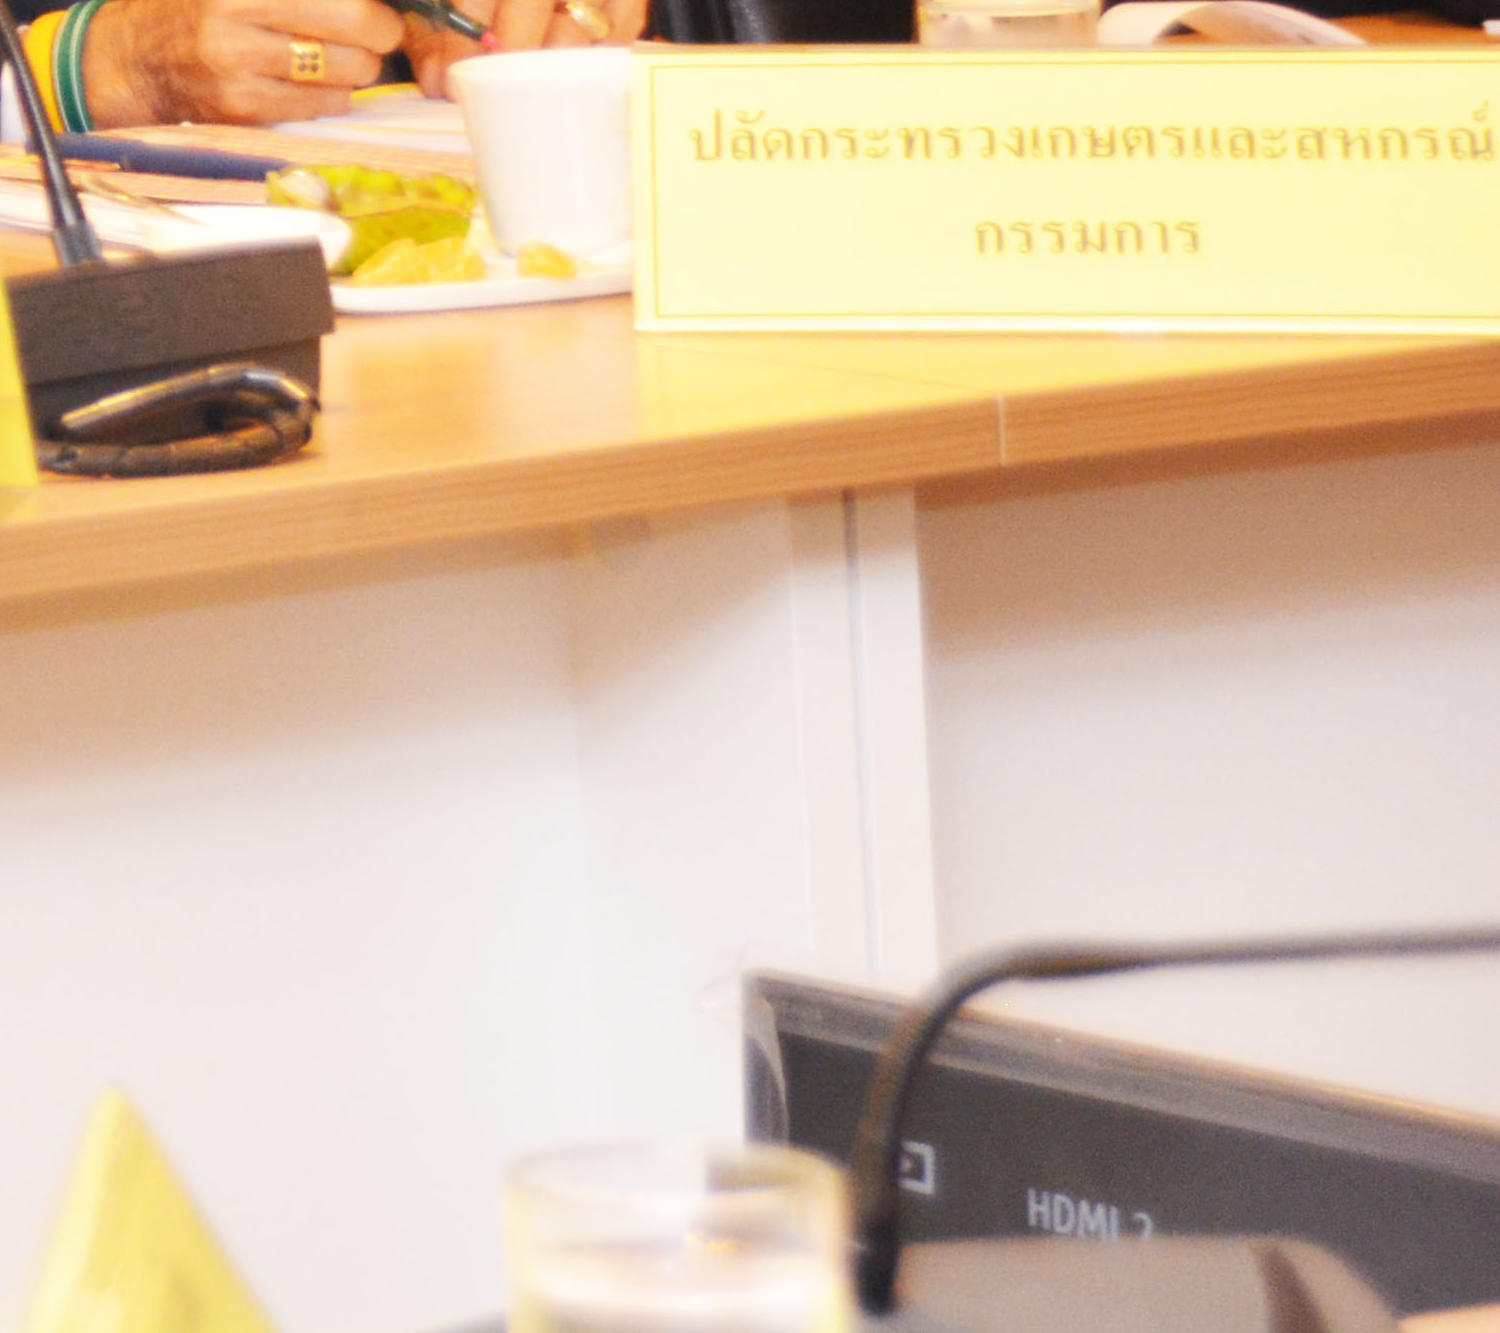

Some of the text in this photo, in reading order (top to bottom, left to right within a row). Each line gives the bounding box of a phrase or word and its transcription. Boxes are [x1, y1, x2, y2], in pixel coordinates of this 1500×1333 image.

[687, 99, 1497, 162] ปลัดกระทรวงเกษตรและสหกรณ์
[974, 219, 1201, 255] กรรมการ
[1026, 1186, 1119, 1241] HDMI
